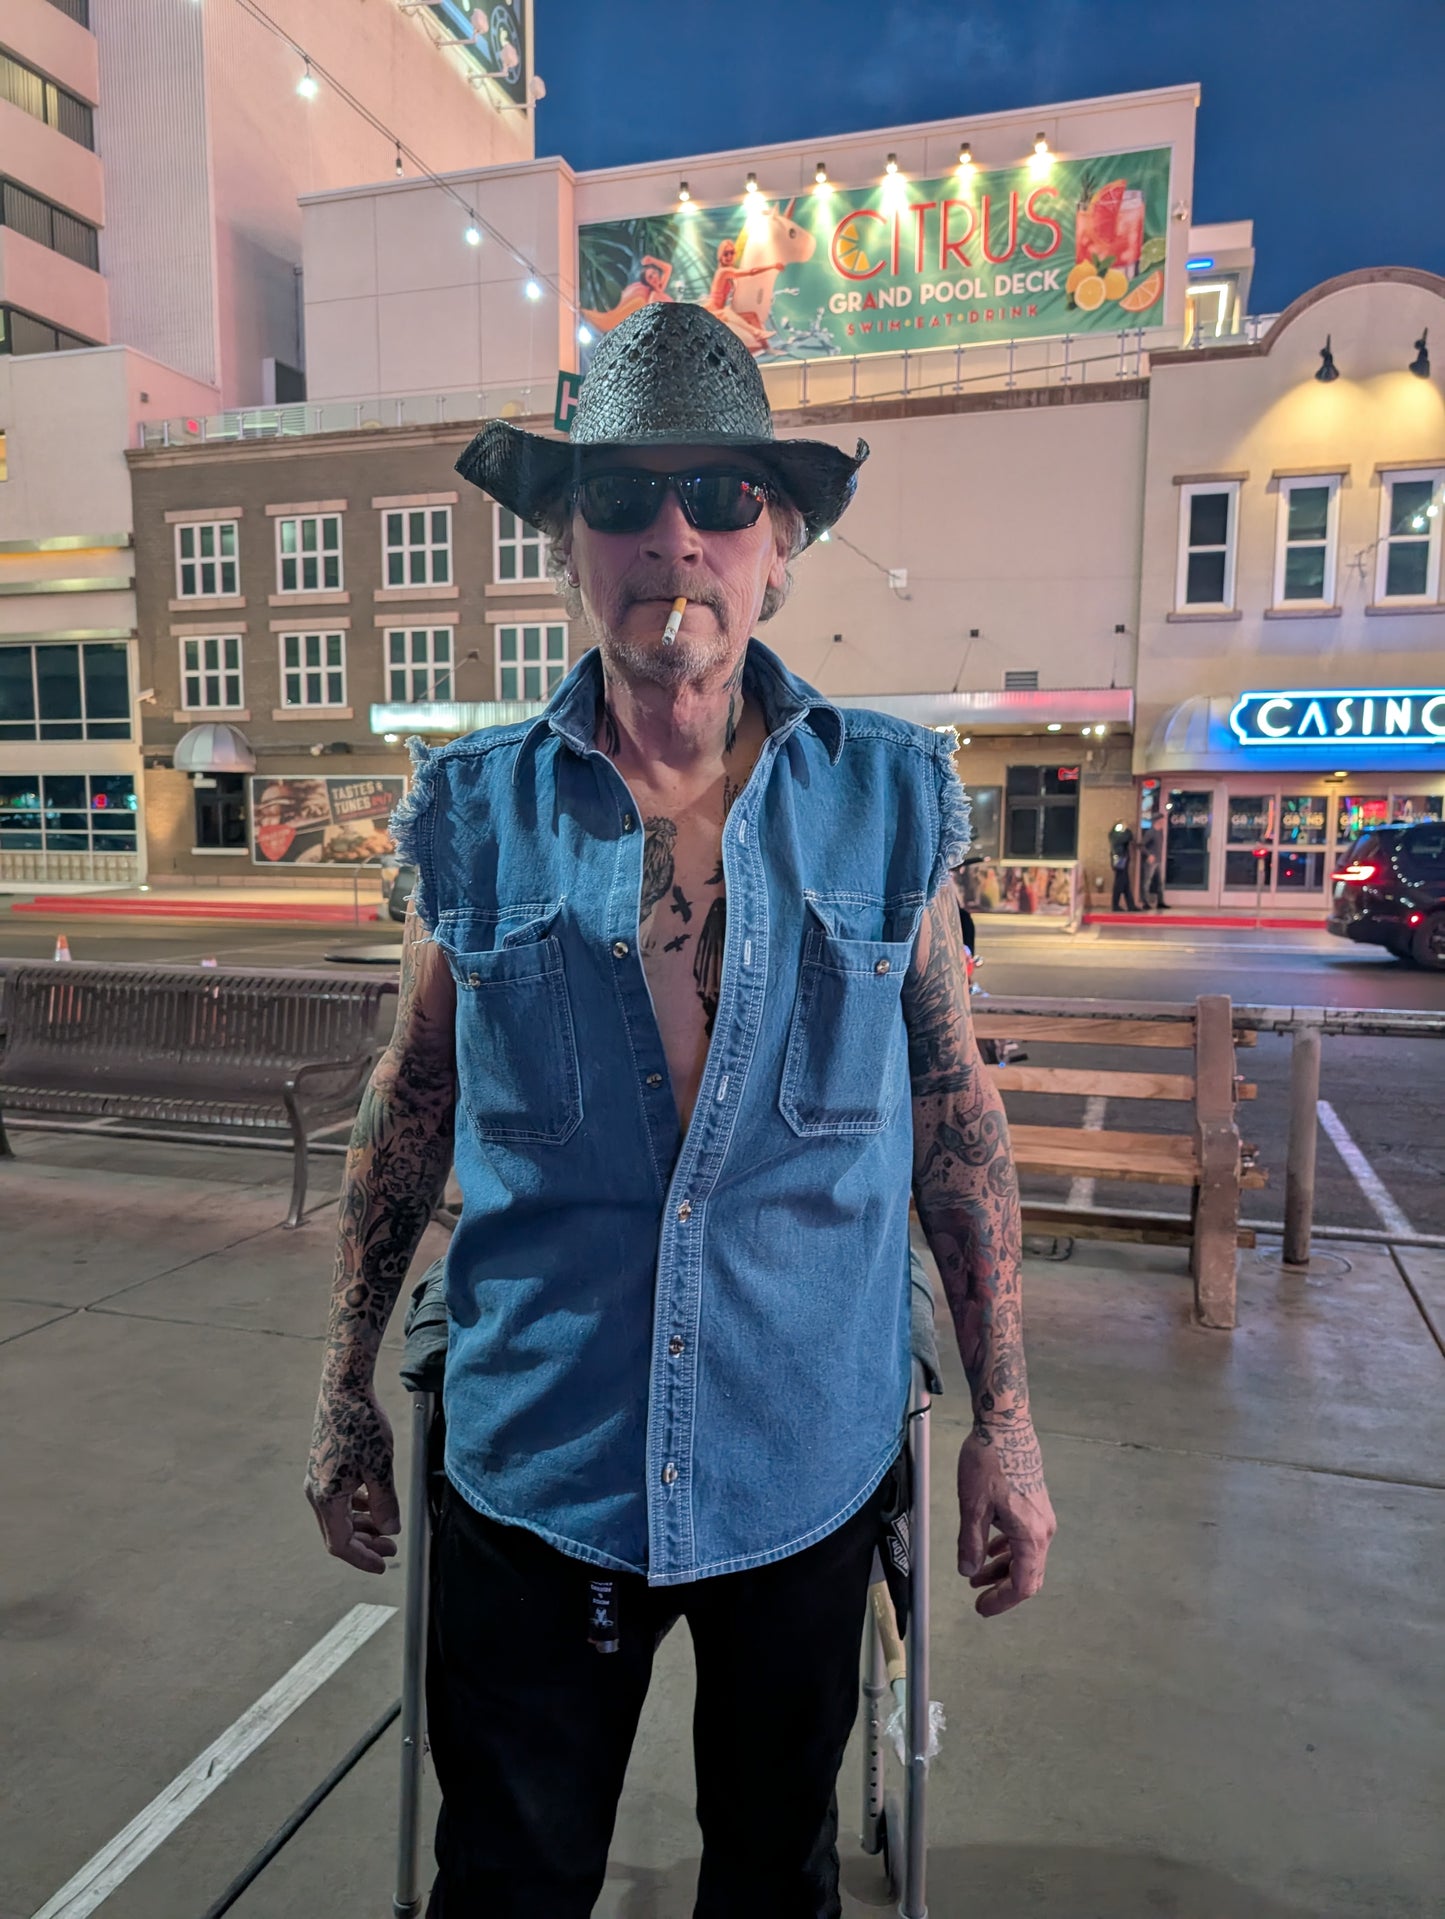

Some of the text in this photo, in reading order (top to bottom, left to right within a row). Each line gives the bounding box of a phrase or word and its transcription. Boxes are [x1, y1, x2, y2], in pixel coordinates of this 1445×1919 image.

[828, 187, 1063, 281] CITRUS
[829, 269, 1061, 314] GRAND POOL DECK
[846, 304, 1038, 336] SWIM EAT DRINK
[331, 781, 375, 801] TASTES
[334, 796, 372, 815] TUNES
